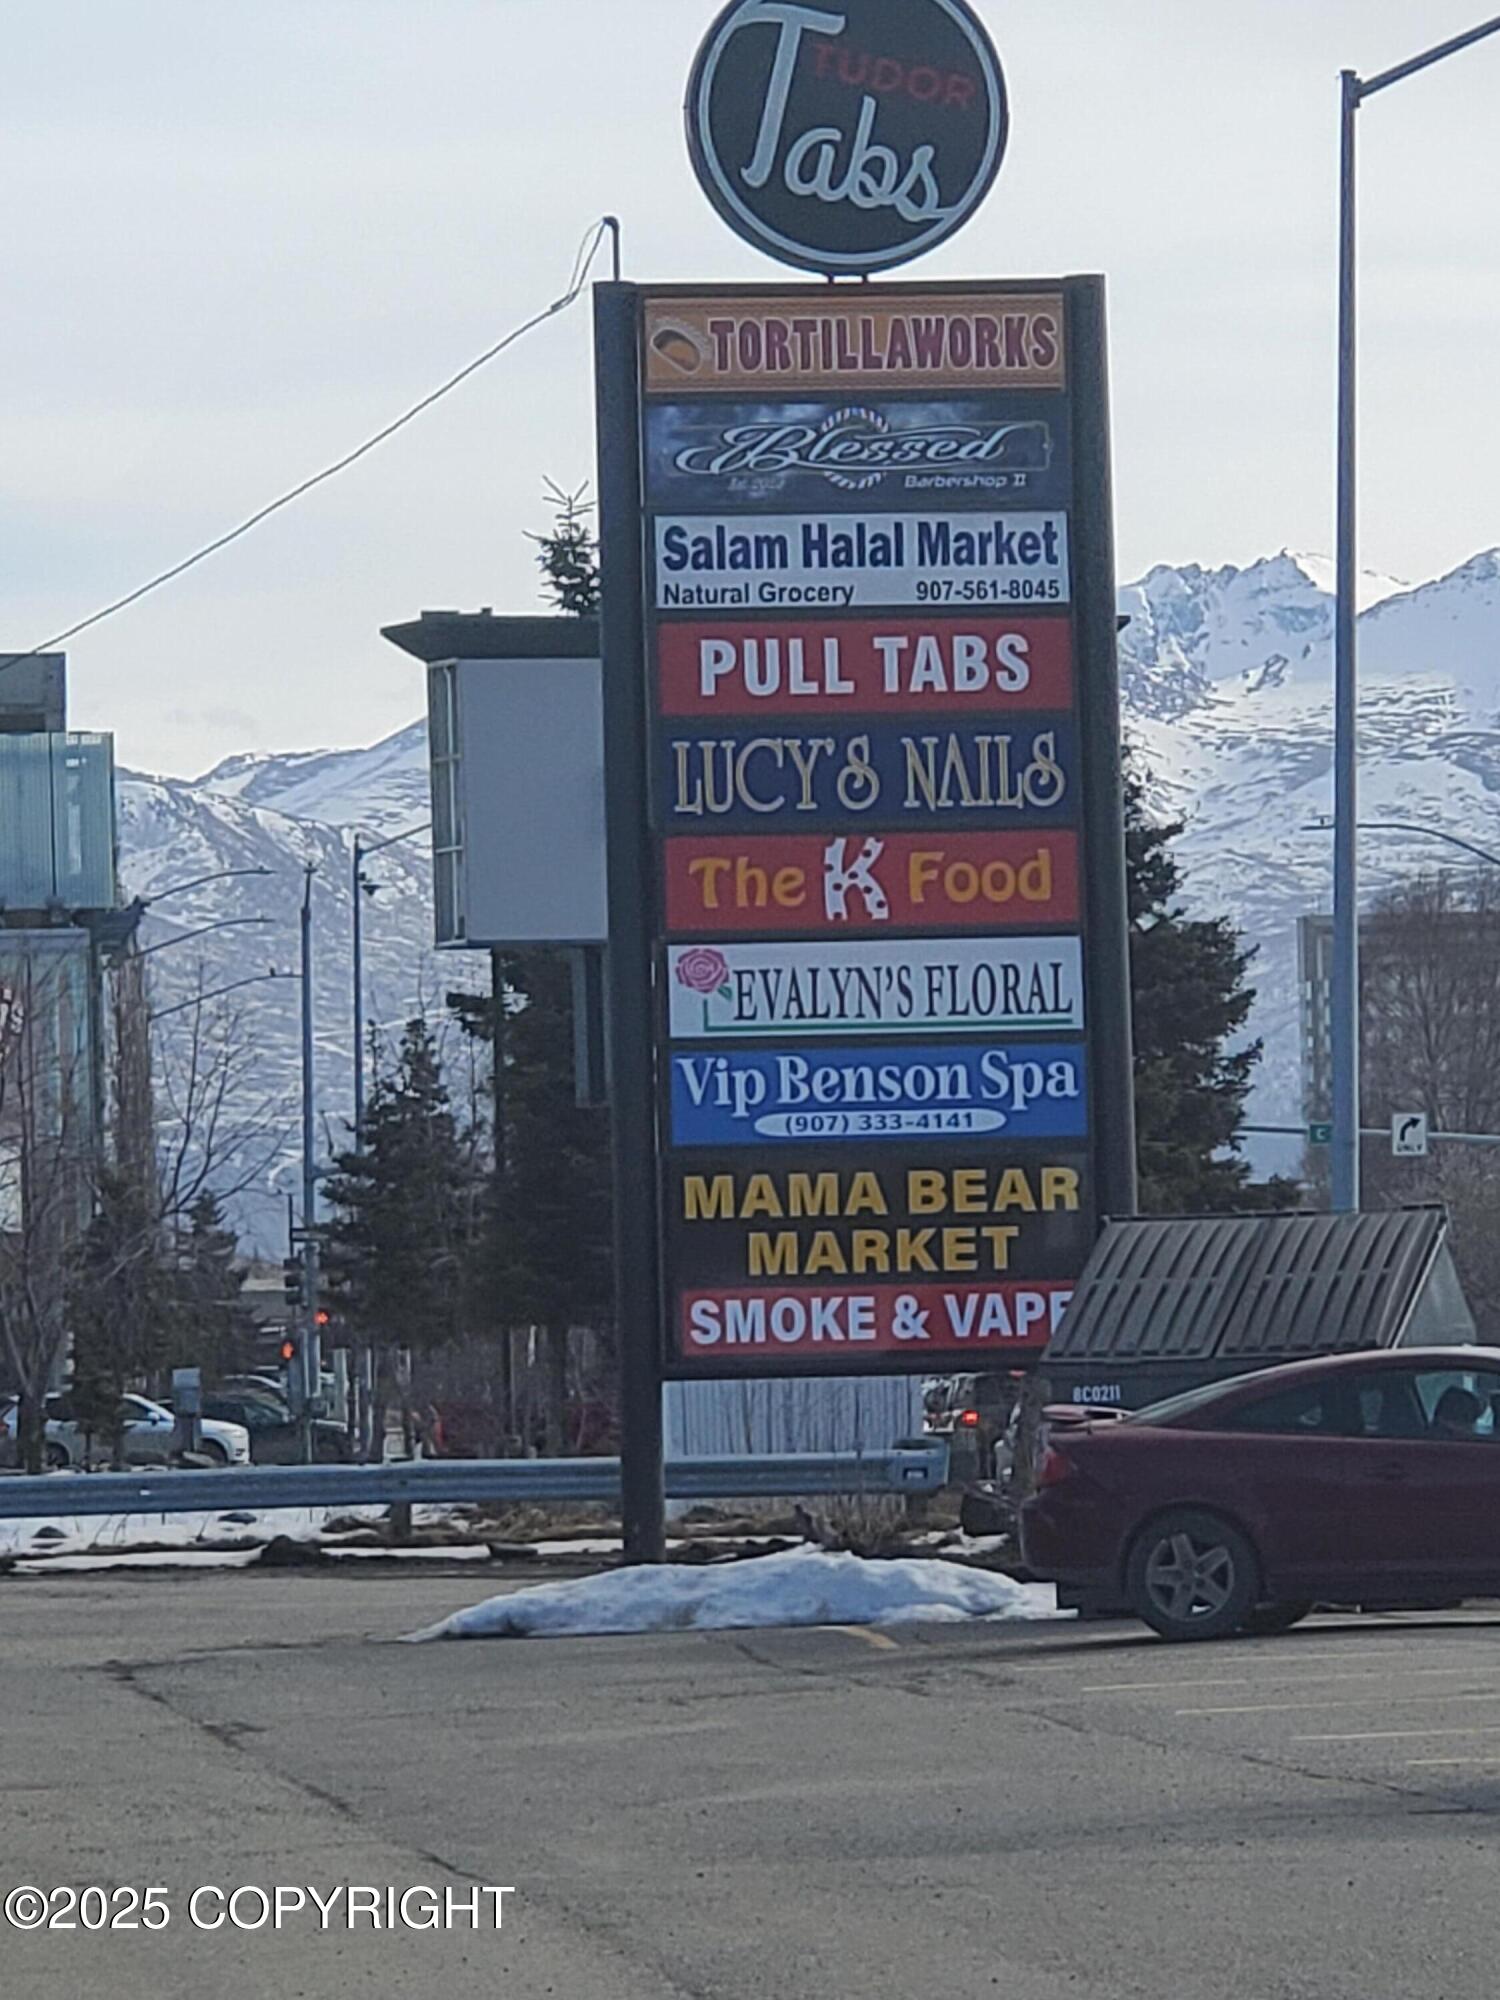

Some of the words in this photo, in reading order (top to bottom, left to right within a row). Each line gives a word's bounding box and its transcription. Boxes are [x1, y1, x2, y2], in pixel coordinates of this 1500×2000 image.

[811, 42, 977, 105] TUDOR
[738, 2, 950, 222] Tabs
[708, 313, 1059, 374] TORTILLAWORKS
[676, 420, 1020, 476] Blessed
[904, 473, 1007, 490] Barbershop
[663, 524, 788, 571] Salam
[801, 521, 904, 569] Halal
[917, 518, 1060, 567] Market
[663, 581, 750, 605] Natural
[758, 581, 855, 606] Grocery
[915, 579, 1060, 602] 907-561-8045
[700, 637, 855, 697] PULL
[873, 633, 1031, 693] TABS
[671, 733, 880, 815] LUCY'S
[901, 731, 1066, 811] NAILS
[689, 855, 806, 909] The
[823, 836, 890, 921] K
[908, 848, 1053, 904] Food
[734, 963, 913, 1021] EVALYN'S
[923, 961, 1074, 1017] FLORAL
[676, 1057, 766, 1118] Vip
[775, 1056, 971, 1104] Benson
[981, 1050, 1079, 1110] Spa
[785, 1113, 850, 1133] (907)
[858, 1111, 975, 1131] 333-4141
[683, 1171, 888, 1221] MAMA
[907, 1168, 1081, 1214] BEAR
[748, 1225, 1020, 1276] MARKET
[689, 1295, 877, 1345] SMOKE
[891, 1295, 930, 1340] &
